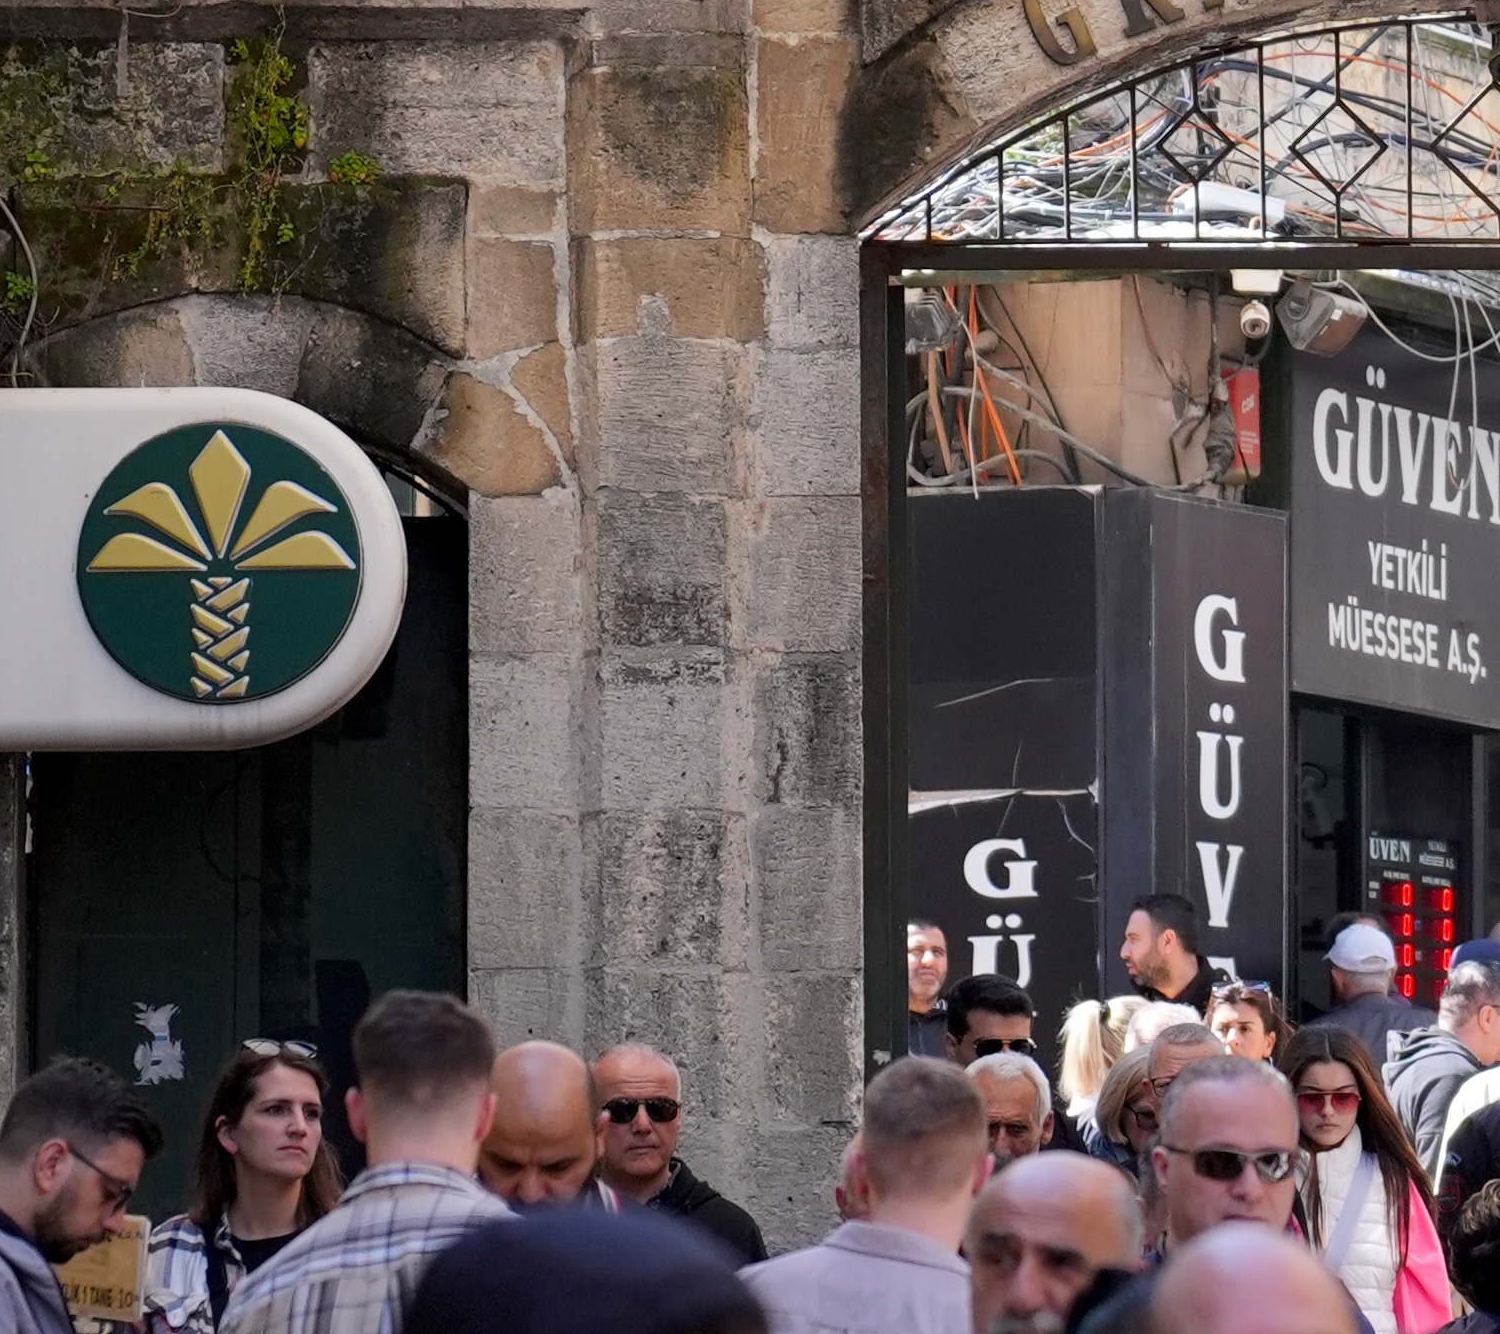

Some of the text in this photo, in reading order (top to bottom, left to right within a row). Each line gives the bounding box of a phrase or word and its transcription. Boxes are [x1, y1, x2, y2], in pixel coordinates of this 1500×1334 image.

[1368, 538, 1448, 602] YETKİLİ
[1327, 595, 1487, 685] MÜESSESE A.Ş.
[1194, 594, 1247, 980] GÜV
